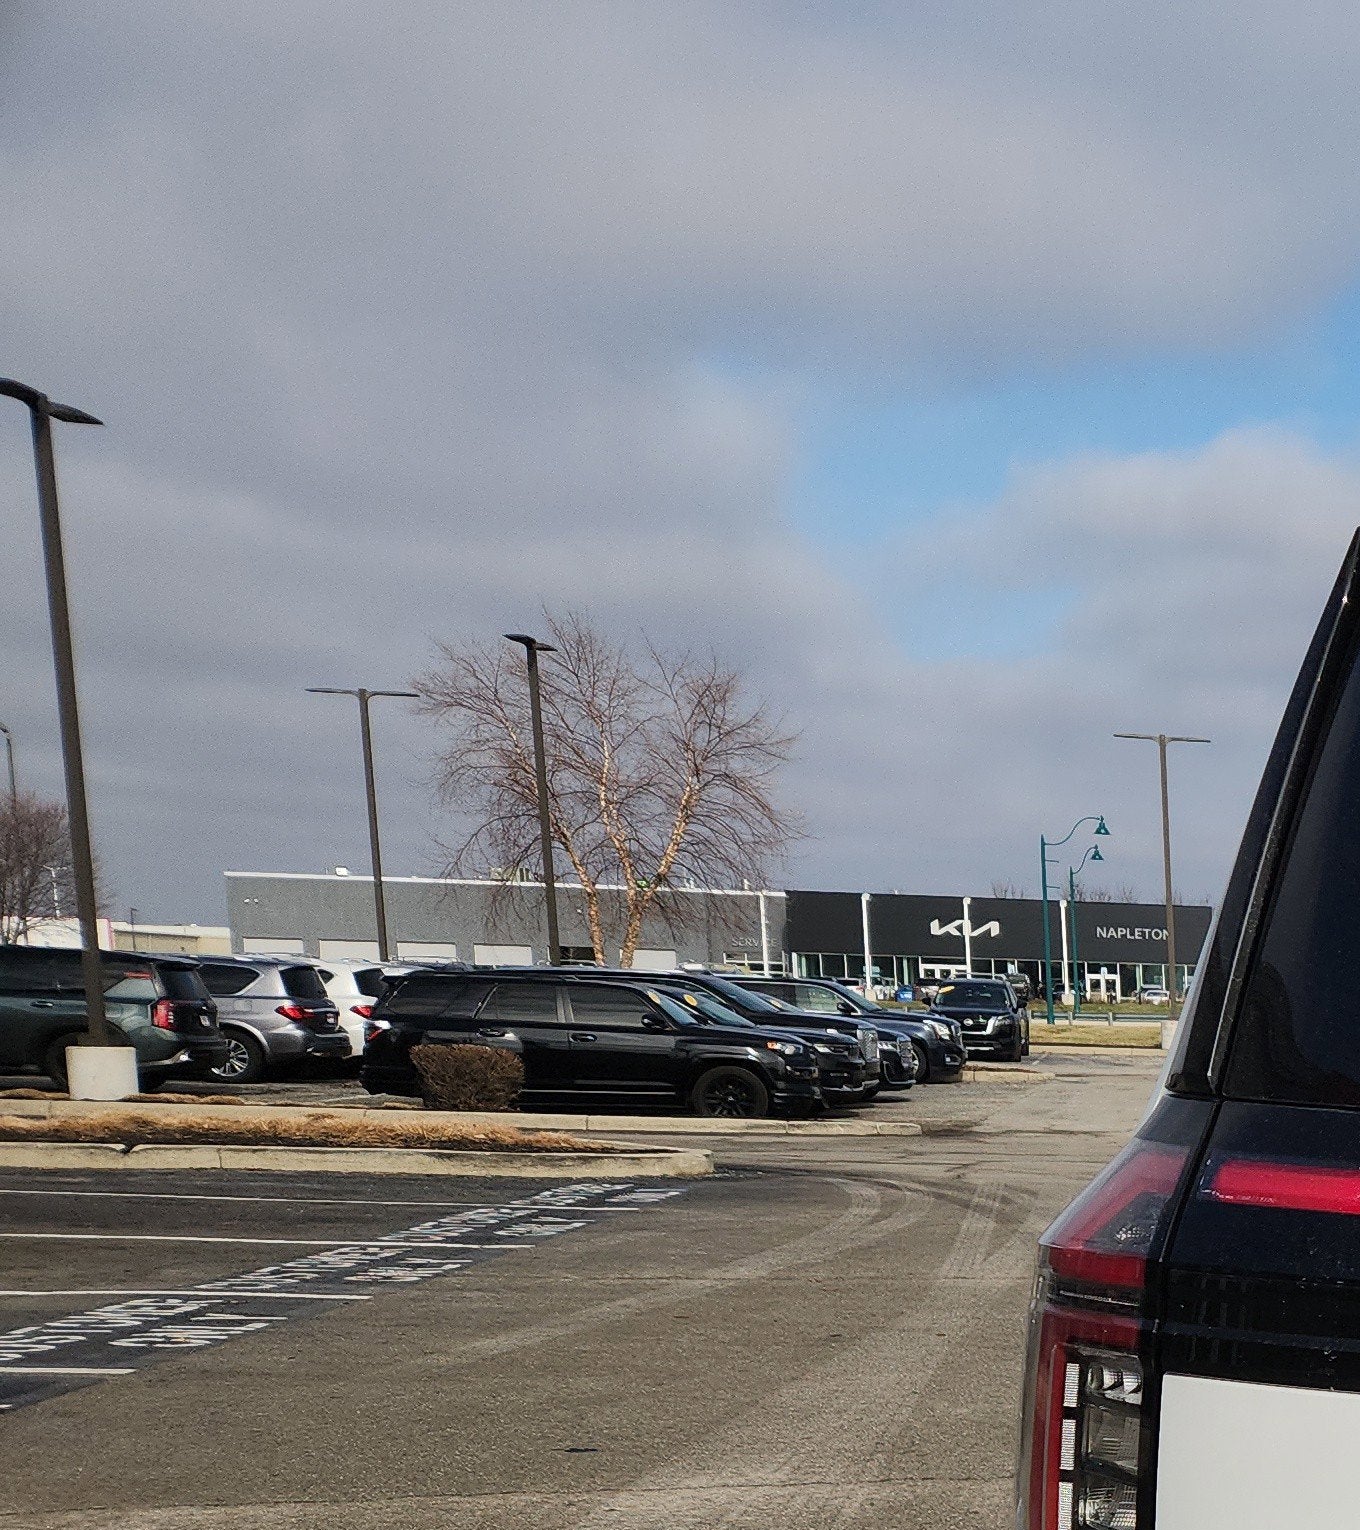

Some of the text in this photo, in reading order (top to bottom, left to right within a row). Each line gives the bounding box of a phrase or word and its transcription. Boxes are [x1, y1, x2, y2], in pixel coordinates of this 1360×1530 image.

[1096, 926, 1169, 941] NAPLETON
[0, 1298, 248, 1361] USTOMER
[107, 1312, 289, 1348] ONLY
